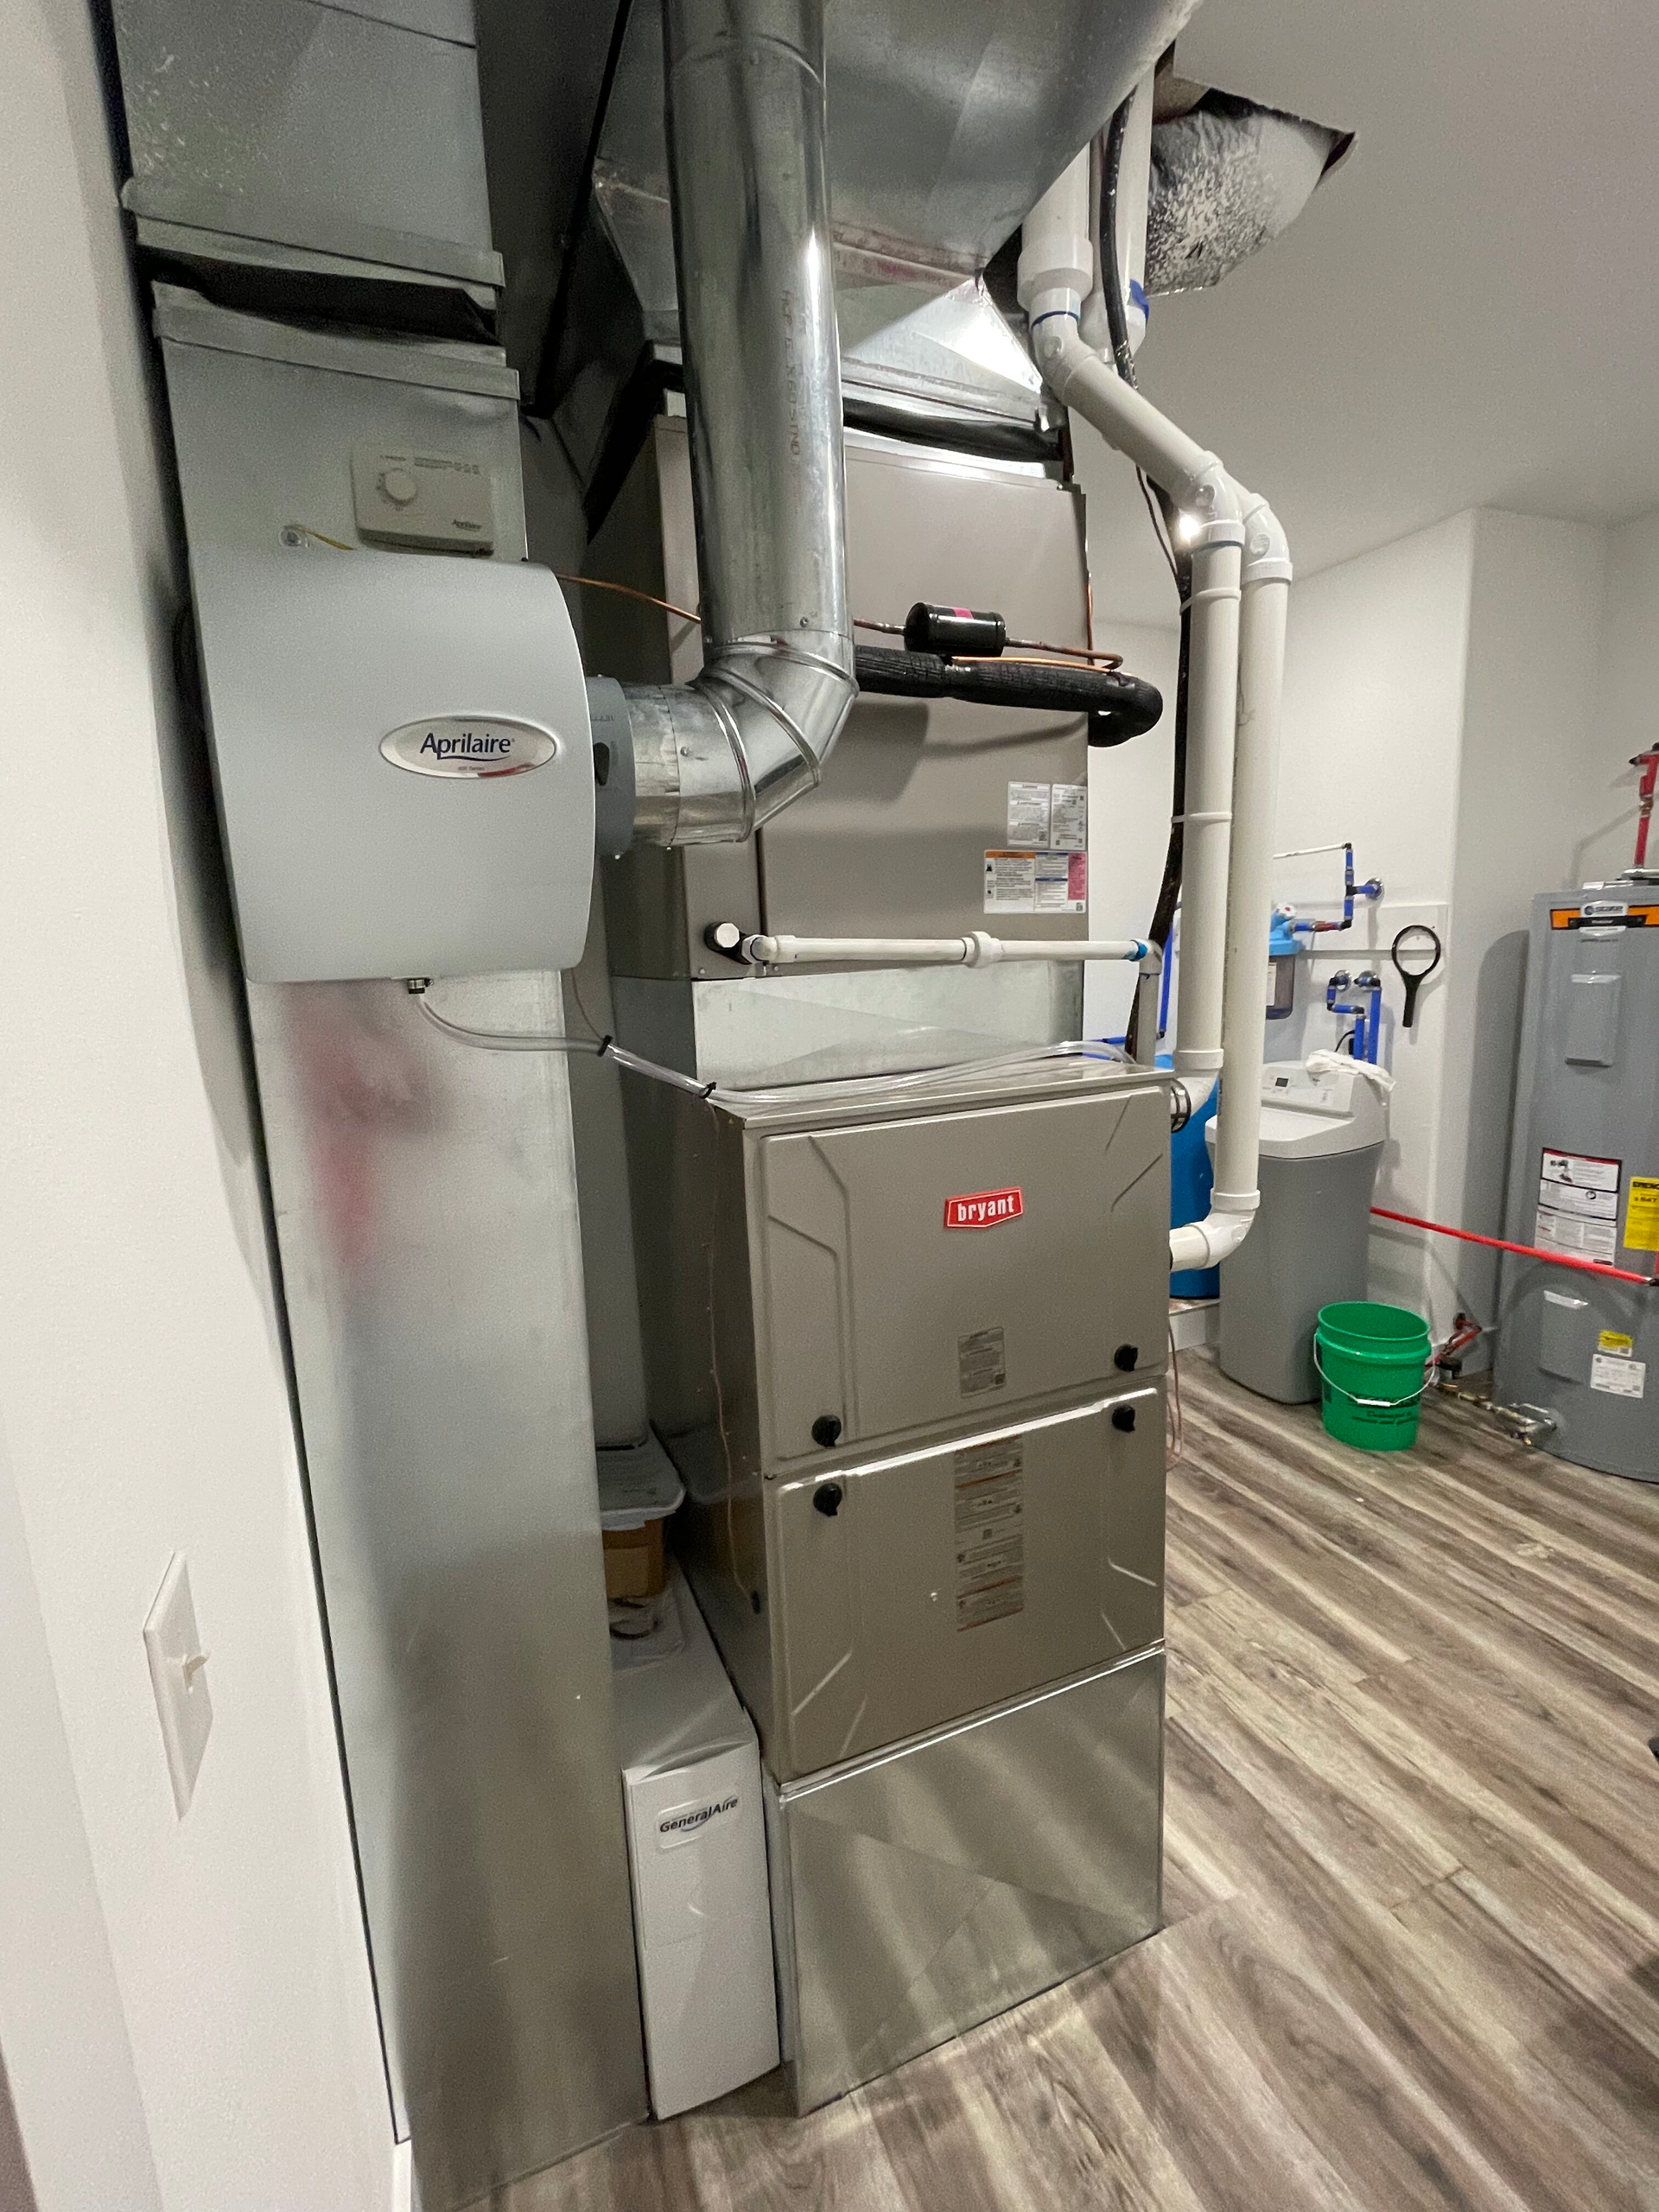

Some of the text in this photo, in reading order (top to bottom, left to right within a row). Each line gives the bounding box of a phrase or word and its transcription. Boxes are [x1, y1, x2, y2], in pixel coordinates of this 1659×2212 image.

[420, 733, 511, 760] Aprilaire
[957, 1195, 1014, 1222] bryant
[659, 1798, 738, 1833] GeneralAire
